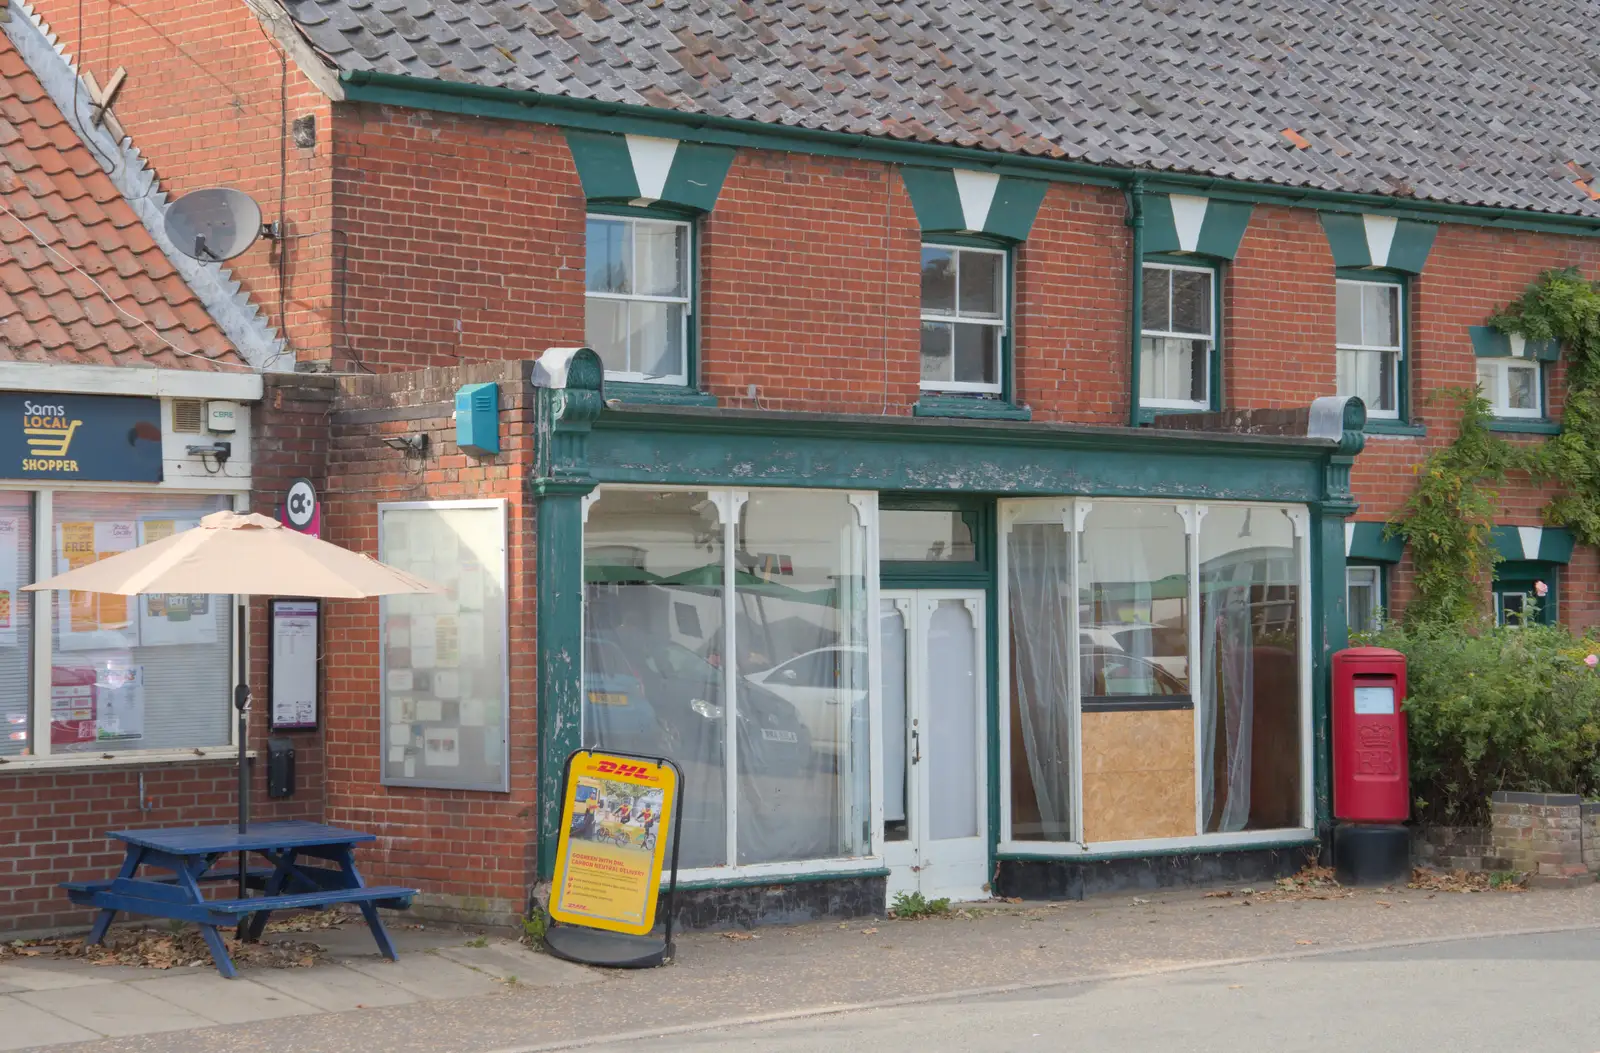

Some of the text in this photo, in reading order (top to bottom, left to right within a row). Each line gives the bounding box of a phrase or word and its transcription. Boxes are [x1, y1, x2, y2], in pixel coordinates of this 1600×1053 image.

[24, 400, 65, 416] Sams
[23, 416, 68, 429] LOCAL
[22, 459, 79, 472] SHOPPER
[65, 542, 93, 552] FREE
[597, 760, 650, 780] DHL
